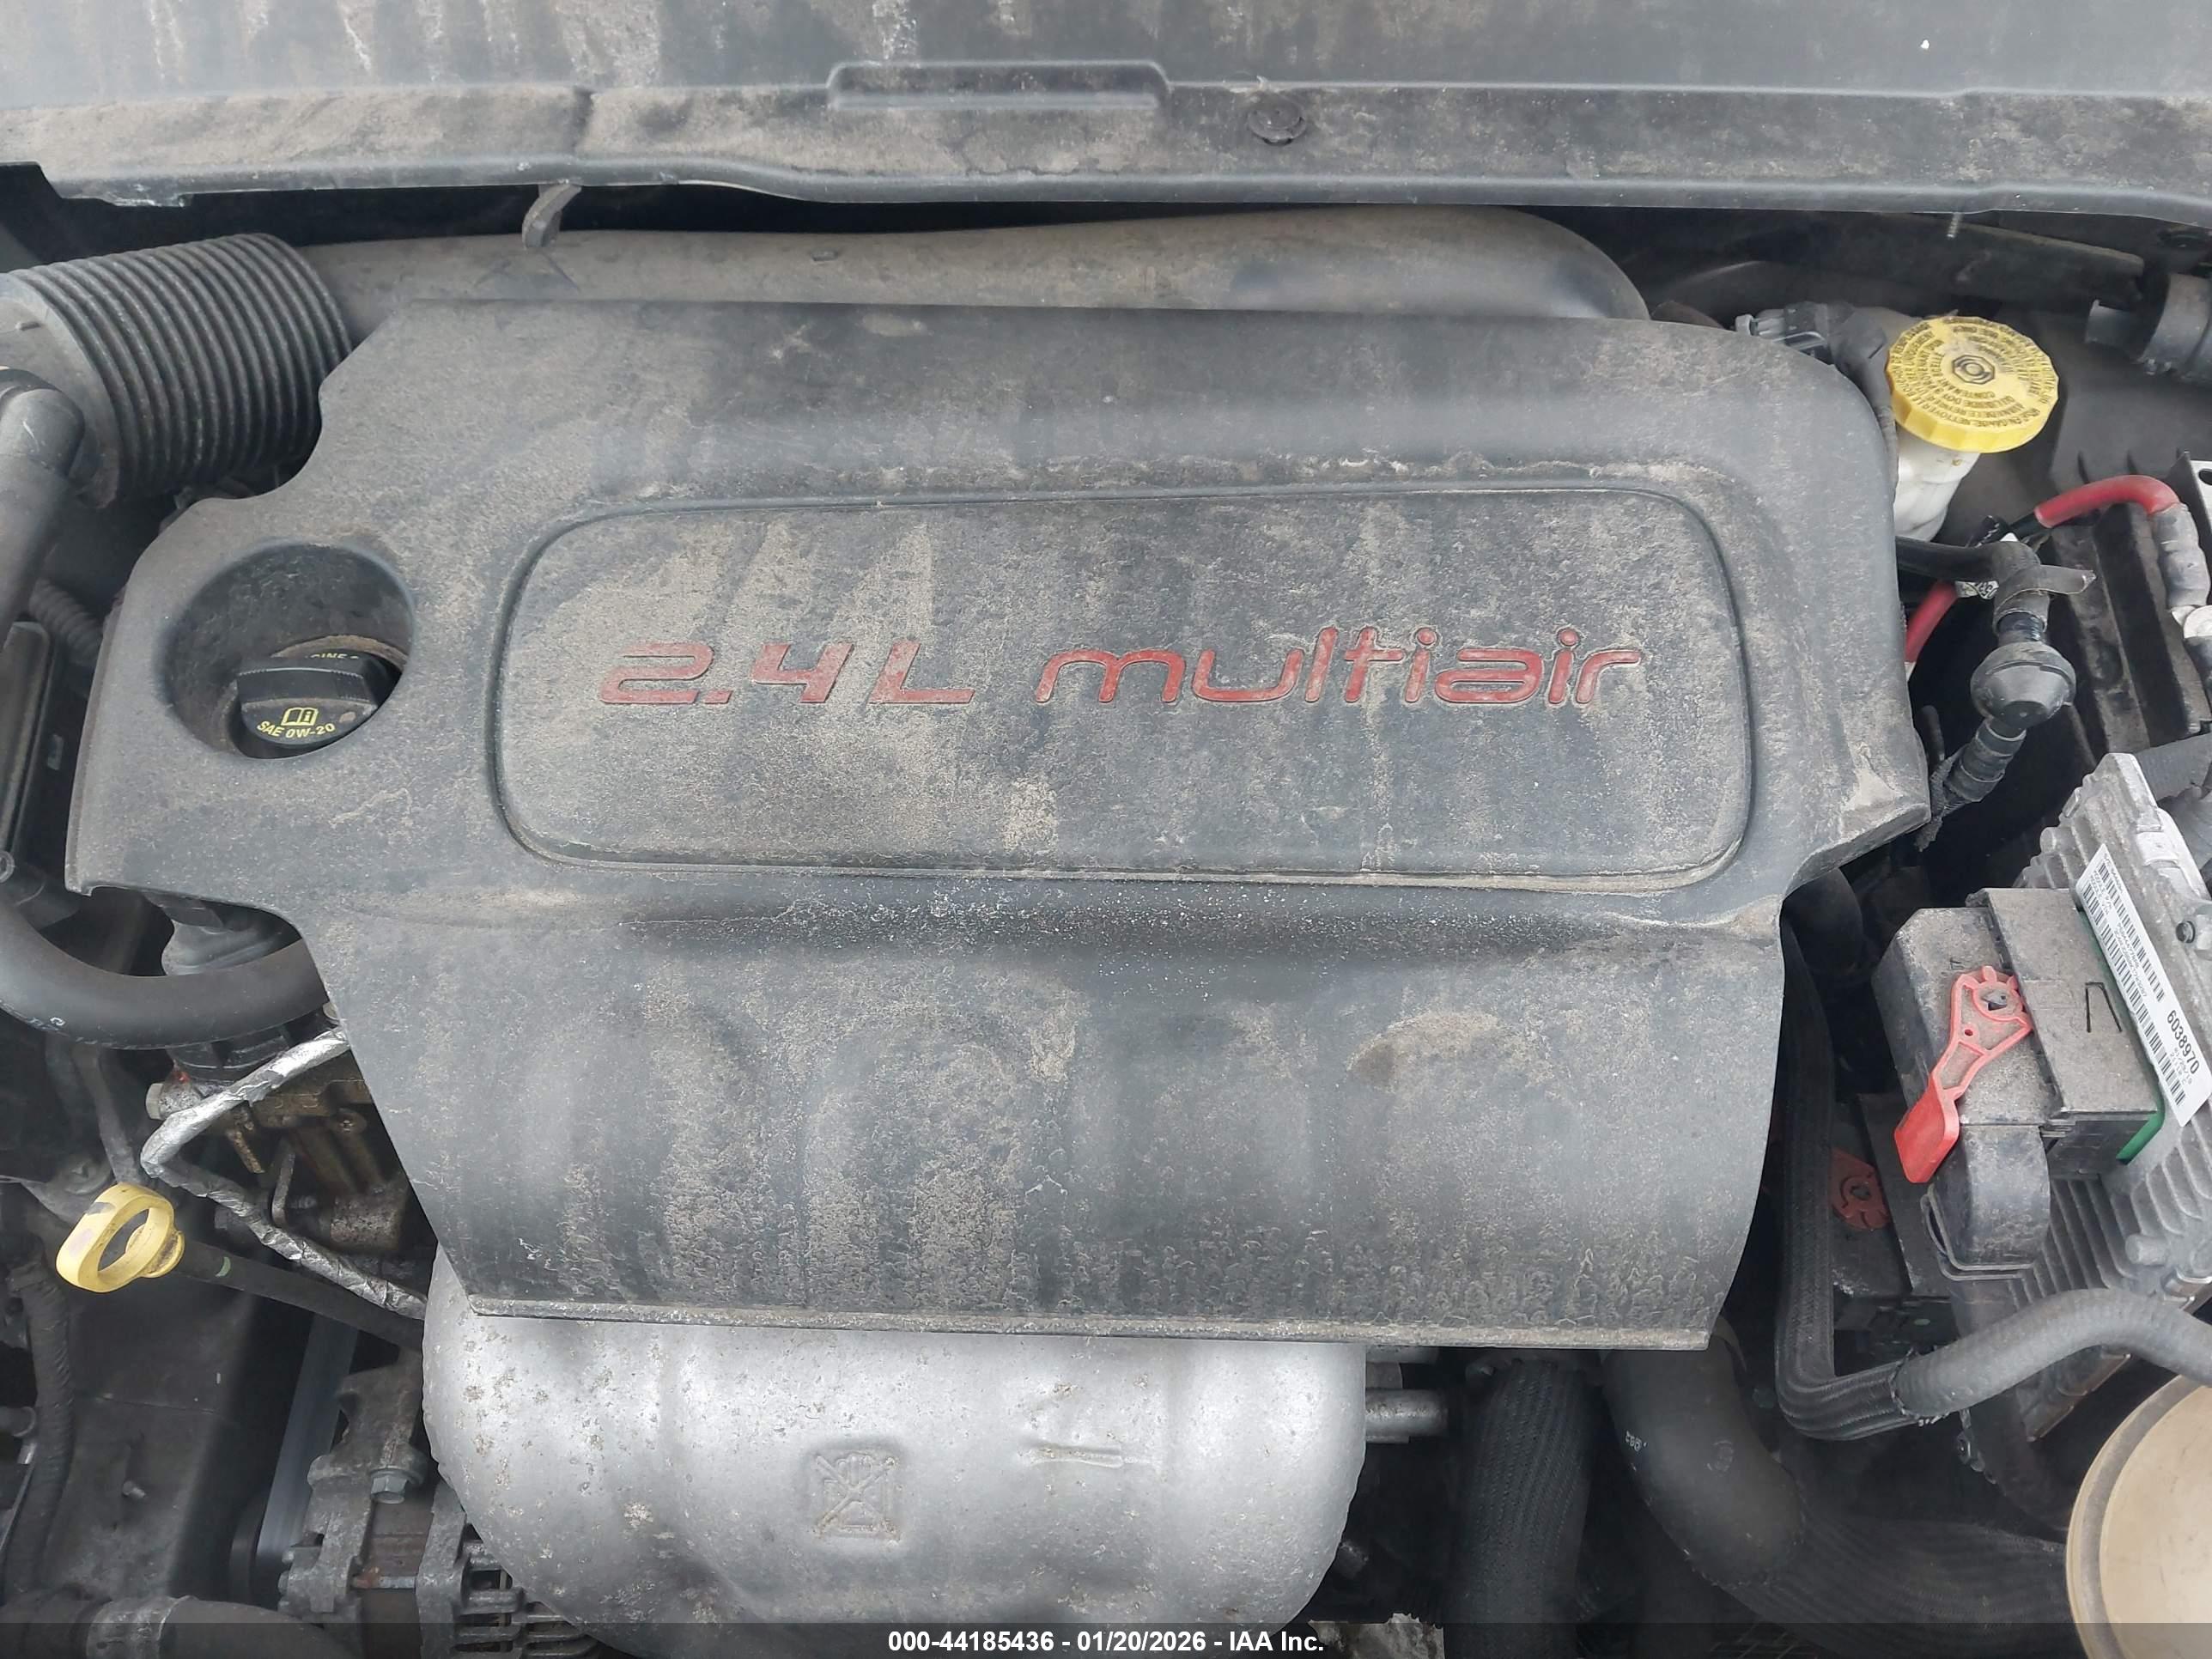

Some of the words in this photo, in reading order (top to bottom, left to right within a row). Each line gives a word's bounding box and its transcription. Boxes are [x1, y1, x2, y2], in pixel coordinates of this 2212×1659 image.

[1034, 623, 1643, 707] multiair
[257, 721, 284, 737] SAE
[286, 723, 336, 738] 0W-20
[2167, 1010, 2199, 1074] 6038970
